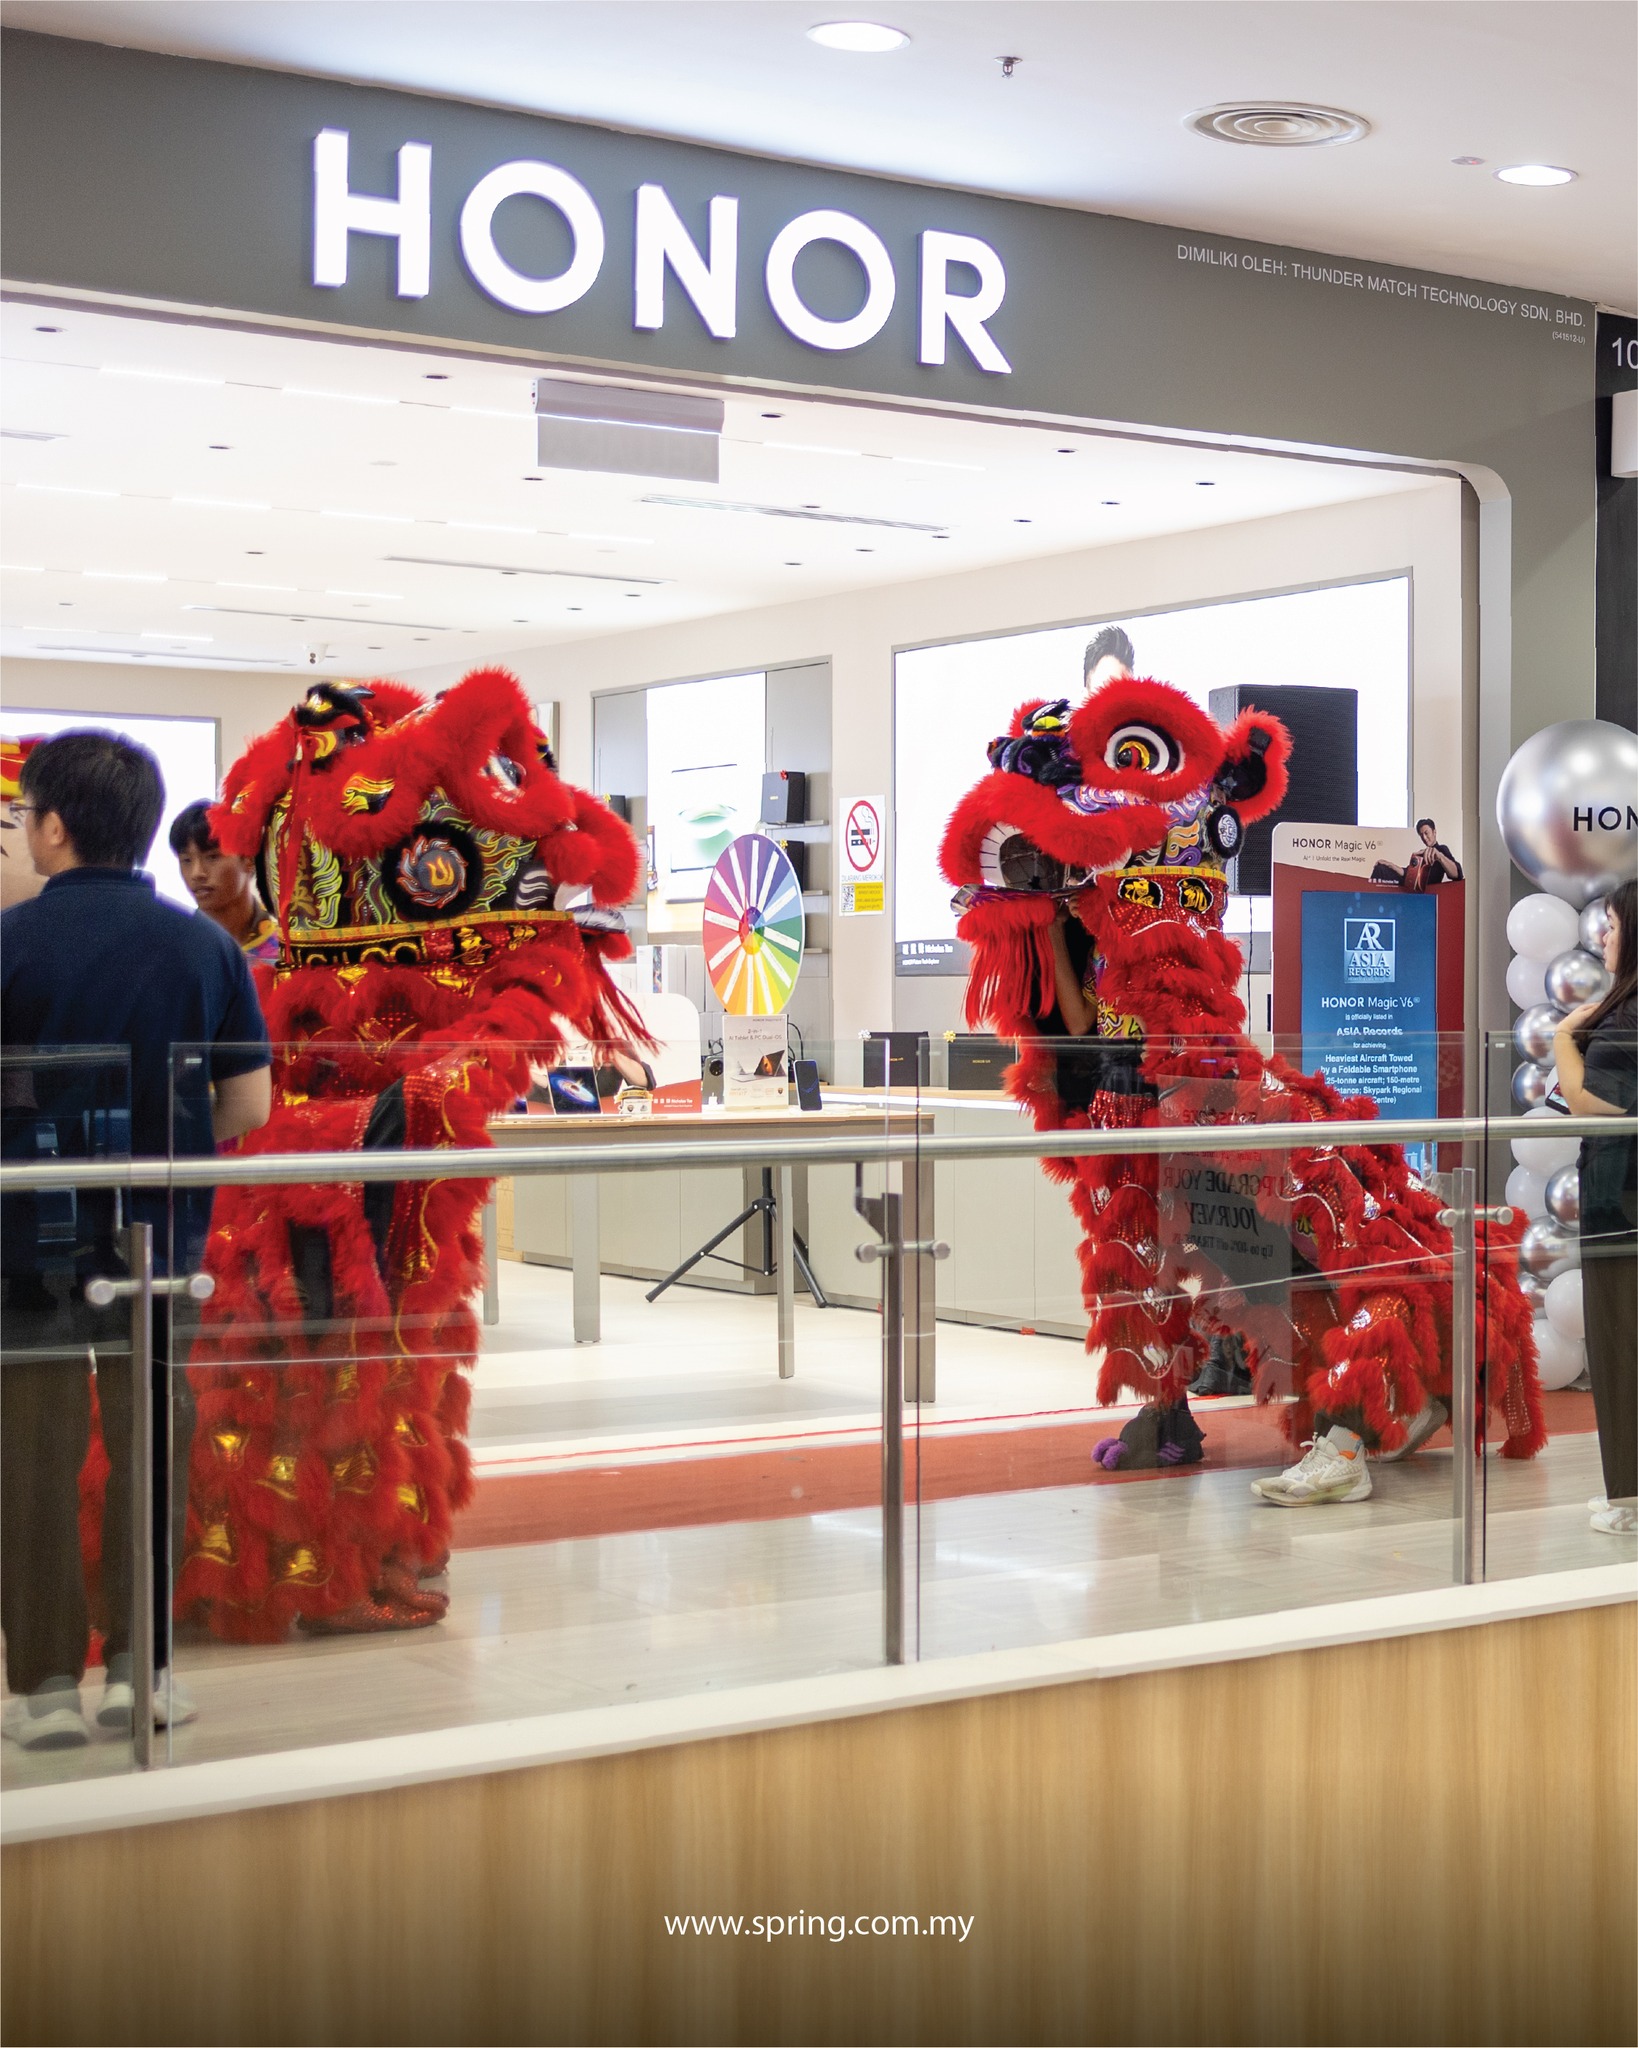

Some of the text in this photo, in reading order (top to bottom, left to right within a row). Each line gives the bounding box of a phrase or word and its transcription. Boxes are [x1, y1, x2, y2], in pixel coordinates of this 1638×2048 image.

[313, 129, 1013, 374] HONOR
[1177, 244, 1586, 327] DIMILIKI OLEH: THUNDER MATCH TECHNOLOGY SDN. BHD.
[1552, 331, 1586, 345] (541512-U)
[1292, 838, 1332, 849] HONOR
[1334, 839, 1363, 853] Magic
[1365, 841, 1377, 850] V6
[1354, 922, 1385, 950] AR
[1348, 952, 1390, 968] ASIA
[1348, 967, 1391, 978] RECORDS
[1321, 996, 1414, 1010] HONOR Magic V6
[1351, 1013, 1372, 1021] officially
[1336, 1026, 1404, 1036] ASIA Records
[1361, 1042, 1387, 1050] achieving
[1325, 1053, 1413, 1062] Heaviest Aircraft Towed
[1320, 1064, 1418, 1075] by a Foldable Smartphone
[1358, 1076, 1386, 1085] aircraft;
[1387, 1076, 1420, 1084] 150-metre
[1362, 1086, 1391, 1096] Skypark
[1392, 1085, 1423, 1095] Regional
[1372, 1096, 1397, 1104] Centre)
